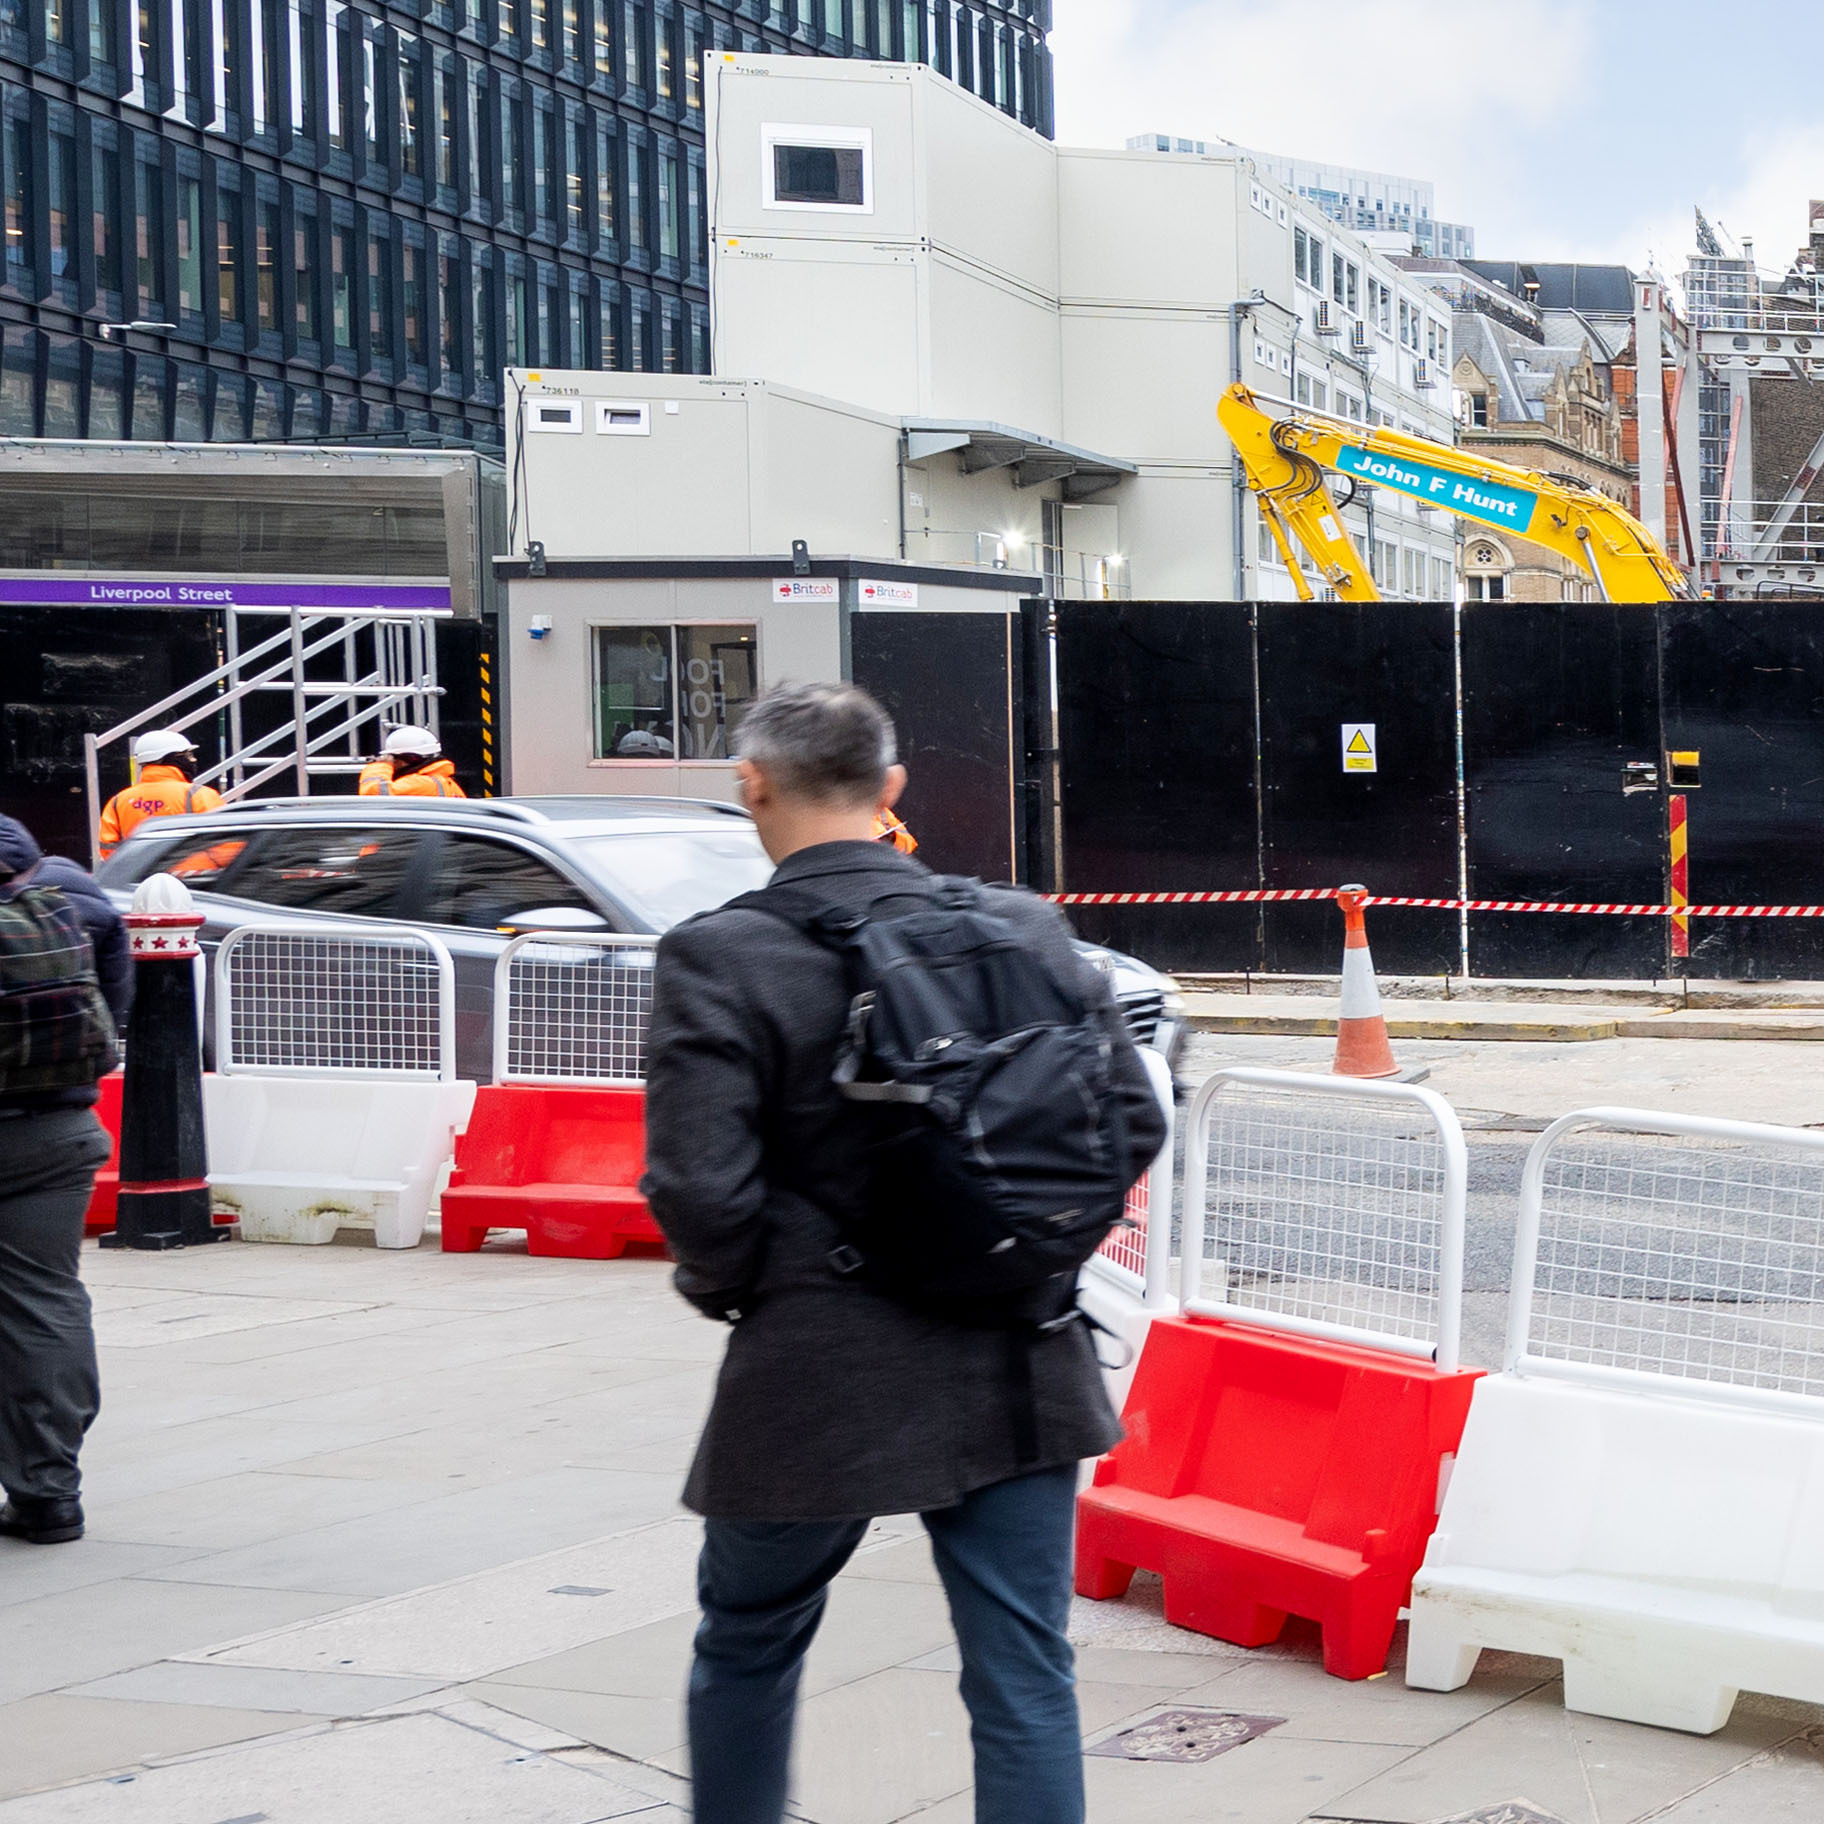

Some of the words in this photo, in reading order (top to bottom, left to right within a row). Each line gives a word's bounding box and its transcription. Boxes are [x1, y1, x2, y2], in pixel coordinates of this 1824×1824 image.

[1353, 456, 1421, 487] John
[1428, 476, 1447, 493] F
[1452, 483, 1518, 517] Hunt
[91, 585, 171, 602] Liverpool
[178, 587, 233, 601] Street
[792, 582, 833, 595] Britcab
[876, 584, 913, 600] Britcab
[133, 797, 164, 815] dgp
